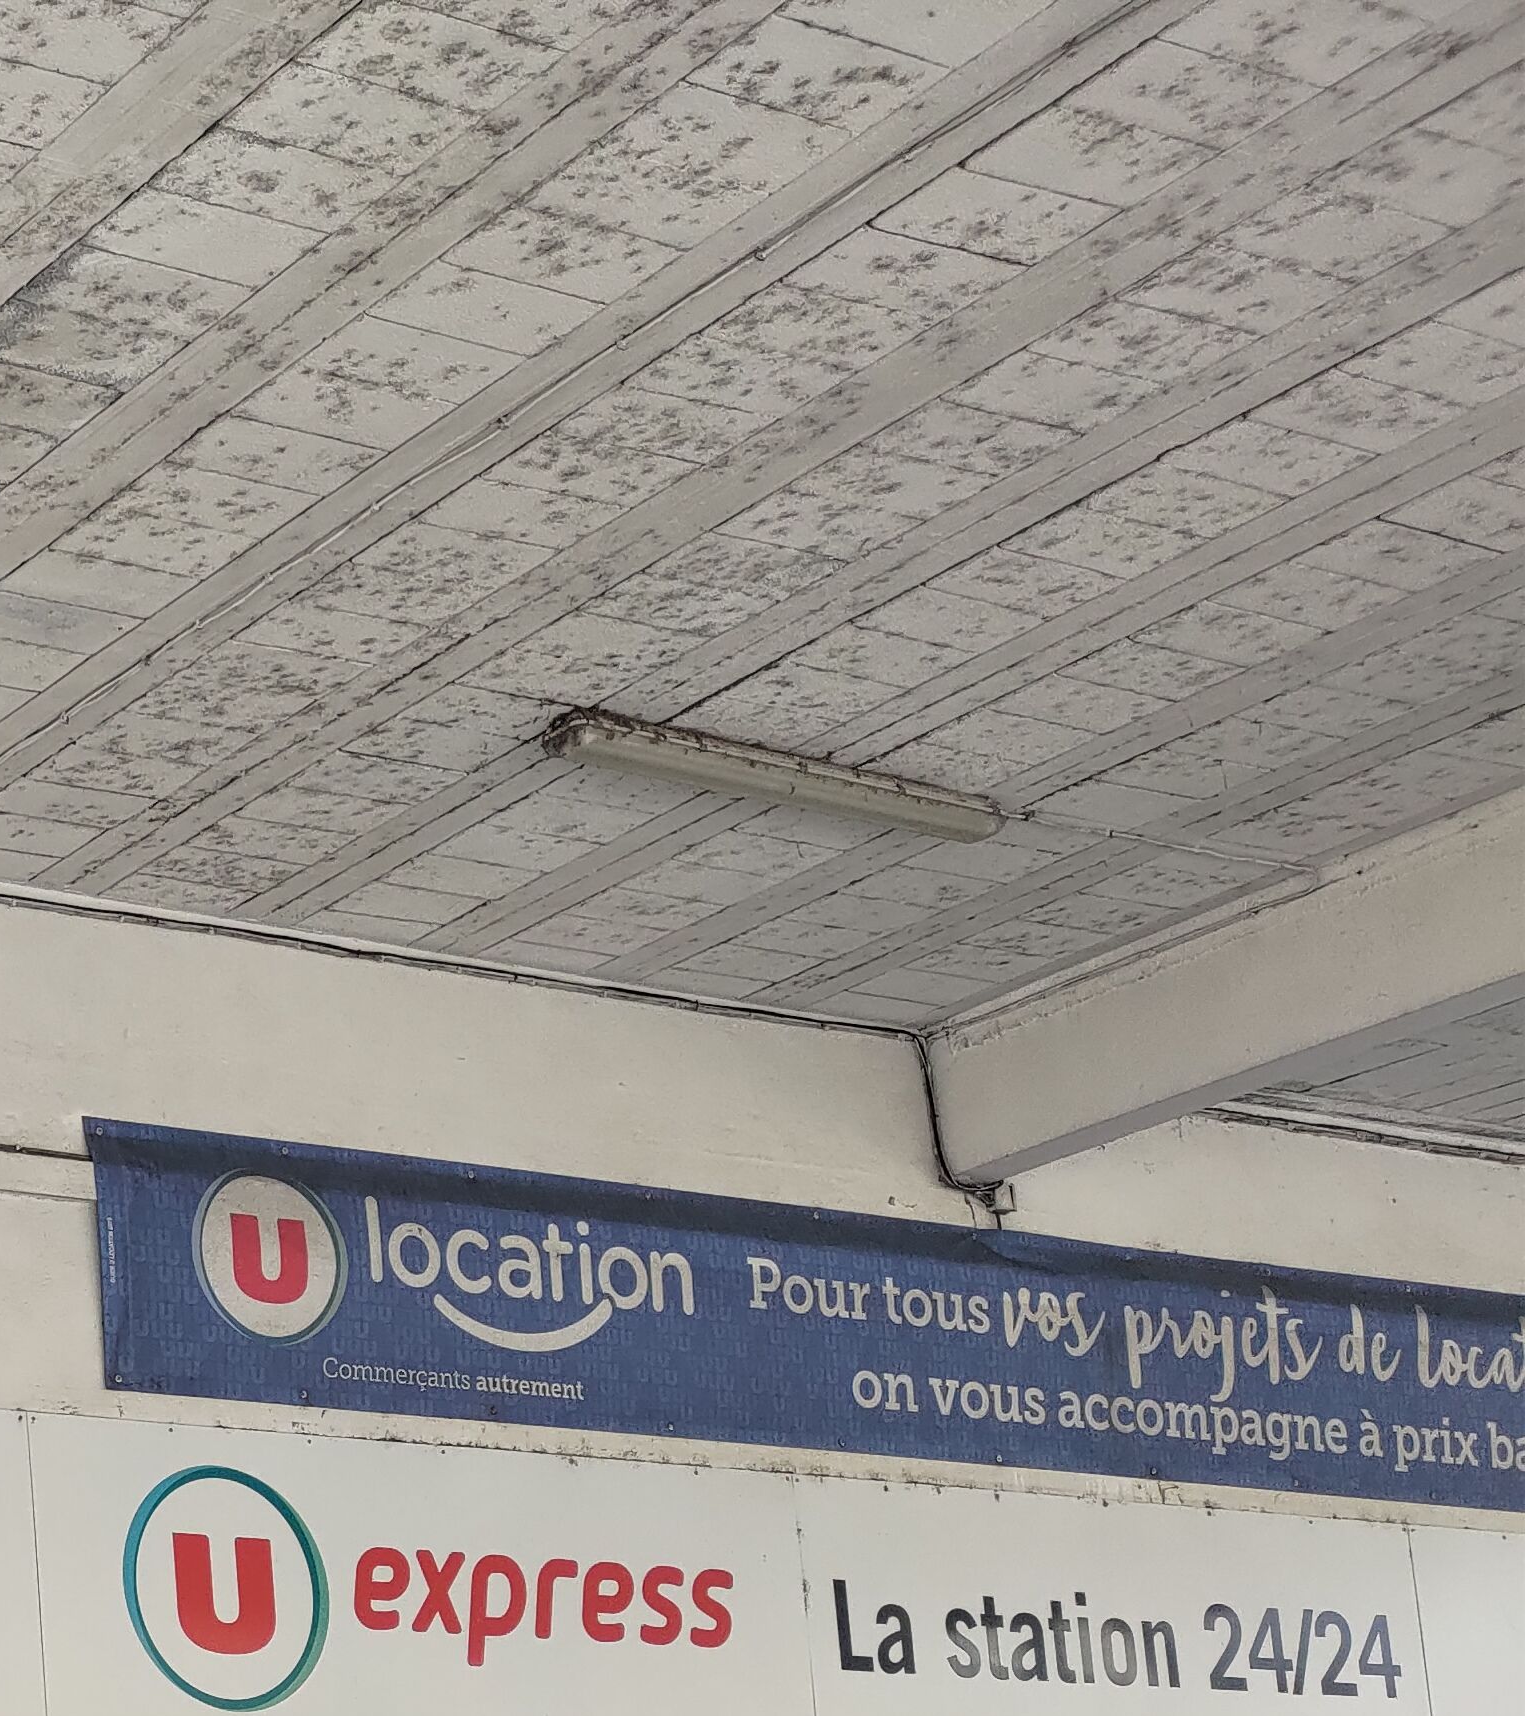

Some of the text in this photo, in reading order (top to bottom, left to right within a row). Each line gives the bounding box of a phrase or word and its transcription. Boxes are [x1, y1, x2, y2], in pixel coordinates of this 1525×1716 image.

[229, 1194, 695, 1317] U location
[322, 1356, 584, 1401] Commerçants autrement
[747, 1257, 870, 1320] Pour
[882, 1276, 990, 1335] tous
[1003, 1286, 1106, 1358] vos
[1123, 1286, 1324, 1401] projets
[1339, 1303, 1402, 1381] de
[852, 1369, 918, 1414] on
[929, 1377, 1046, 1425] vous
[1058, 1390, 1348, 1461] accompagne
[1359, 1408, 1384, 1457] à
[1392, 1416, 1479, 1472] prix
[172, 1532, 734, 1667] U express
[833, 1579, 1402, 1698] La station 24/24
